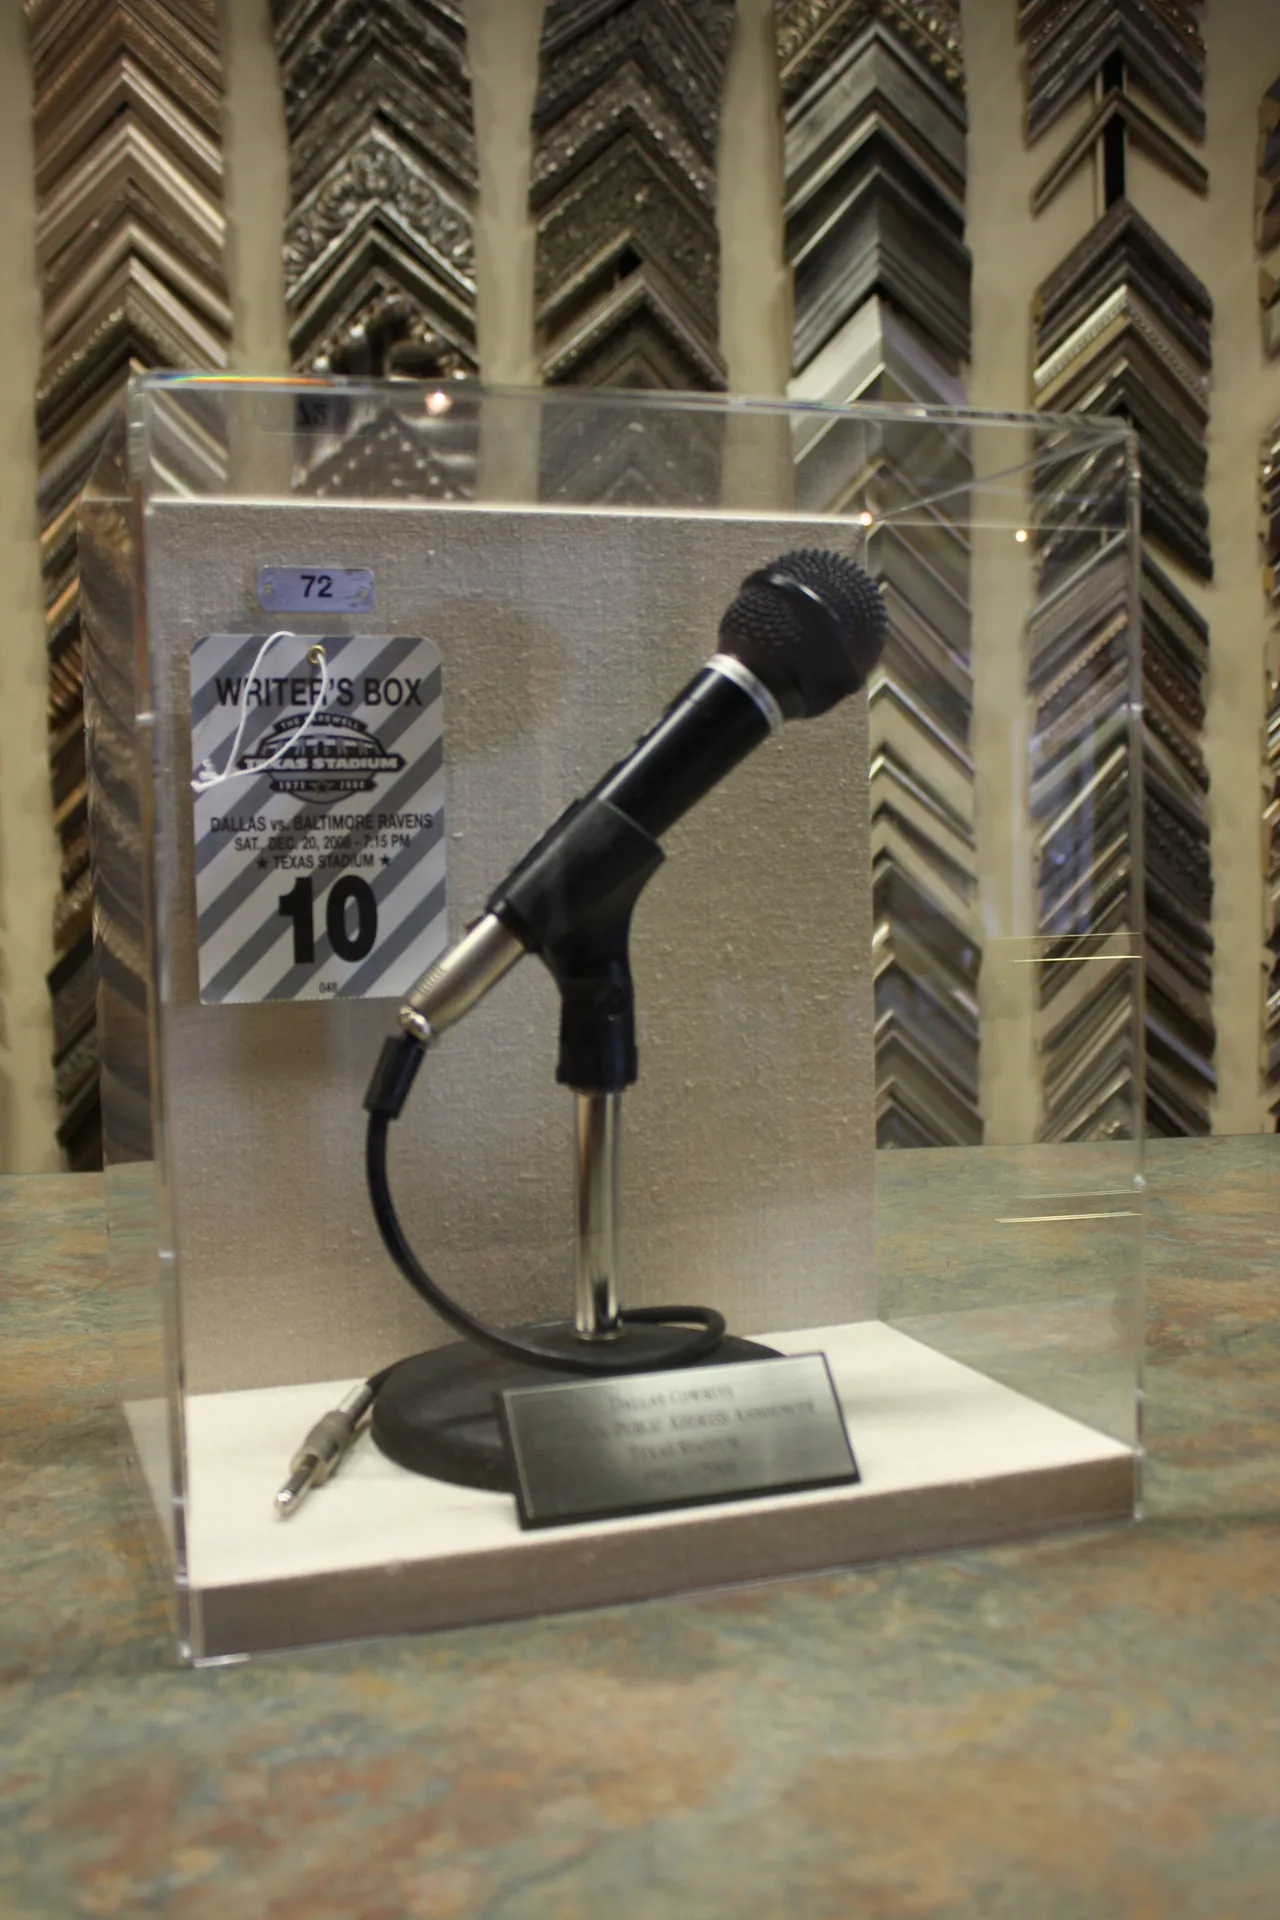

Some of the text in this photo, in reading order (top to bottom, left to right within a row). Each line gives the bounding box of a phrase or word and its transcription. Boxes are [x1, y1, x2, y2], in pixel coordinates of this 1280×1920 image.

[299, 574, 333, 598] 72
[215, 677, 423, 706] WRITER'S BOX
[243, 757, 398, 770] TEXAS STADIUM
[210, 813, 434, 834] DALLAS vs. BALTIMORE RAVENS
[302, 836, 320, 852] 20,
[363, 834, 388, 849] 7:15
[391, 834, 410, 848] PM
[274, 855, 375, 870] TEXAS STADIUM
[278, 874, 378, 964] 10
